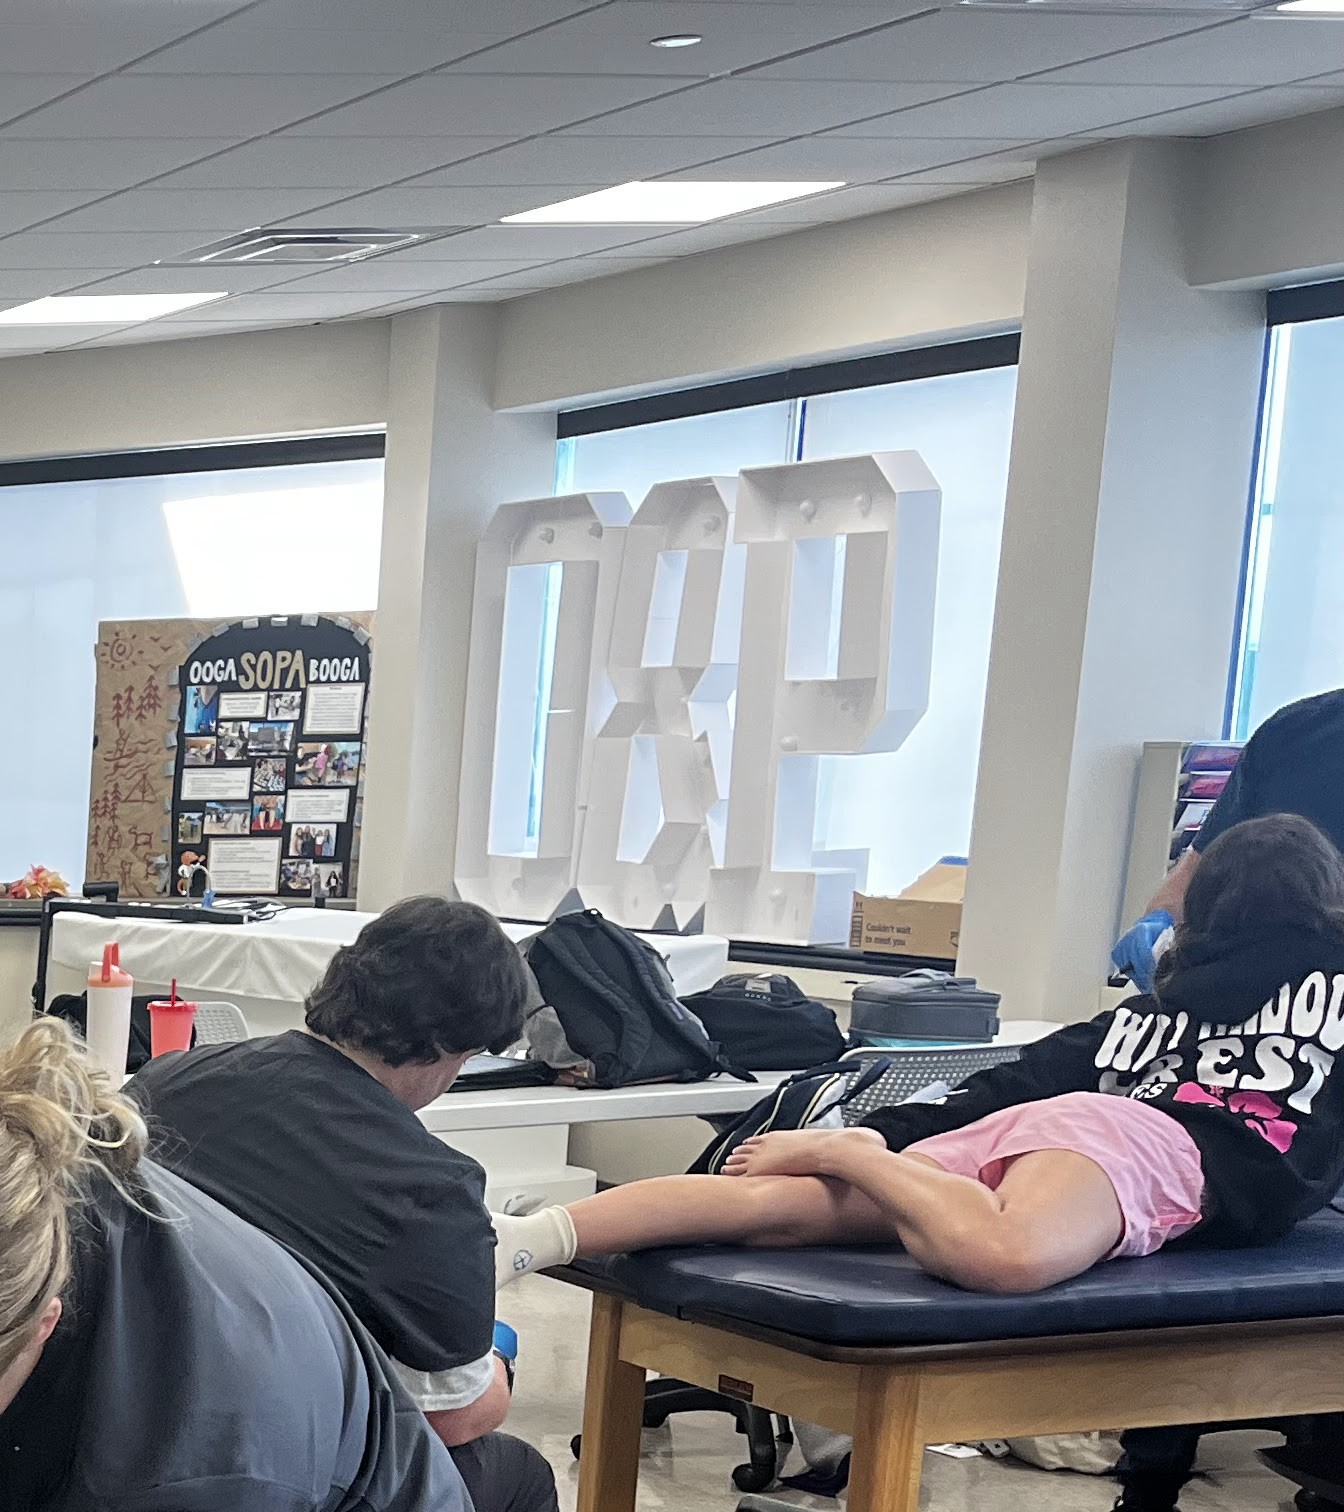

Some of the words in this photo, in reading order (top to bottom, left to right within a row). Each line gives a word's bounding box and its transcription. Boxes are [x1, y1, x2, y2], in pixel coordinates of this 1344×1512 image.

[189, 658, 237, 684] OOGA
[238, 649, 307, 690] SOPA
[308, 656, 360, 682] BOOGA
